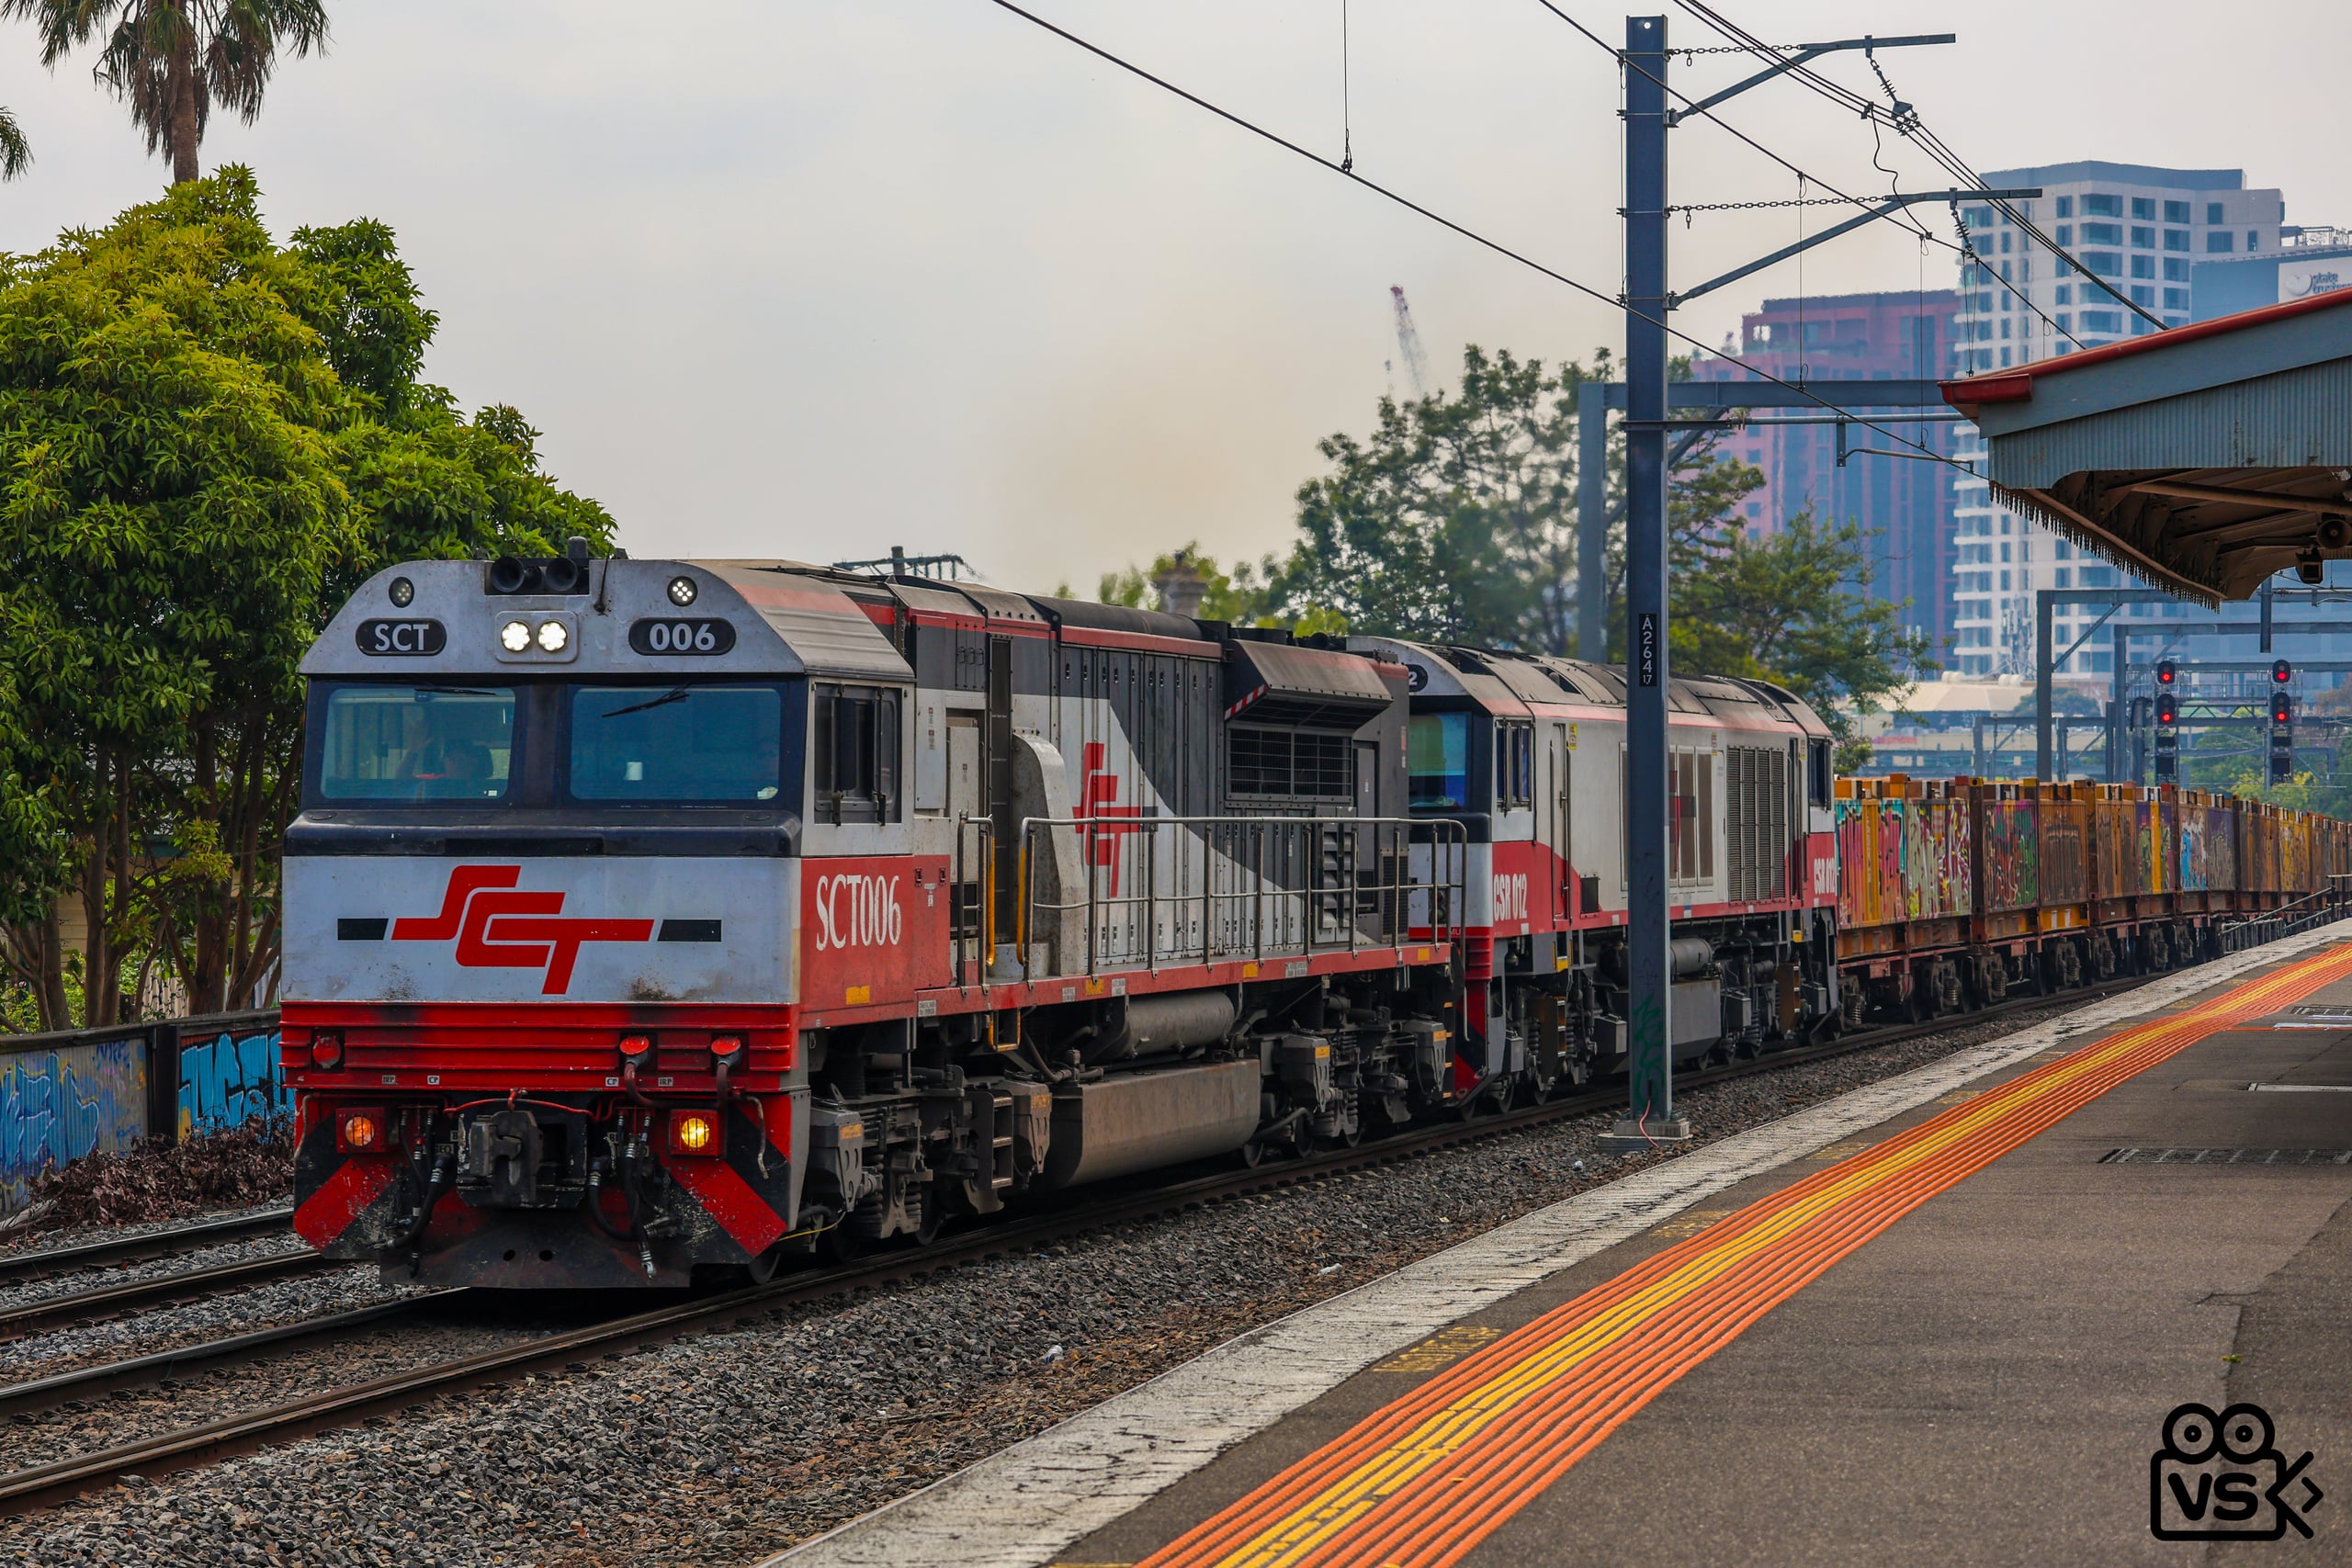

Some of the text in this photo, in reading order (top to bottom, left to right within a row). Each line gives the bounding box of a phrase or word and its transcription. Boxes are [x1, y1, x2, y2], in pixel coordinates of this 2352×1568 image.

[374, 623, 429, 652] SCT
[649, 623, 716, 652] 006
[816, 874, 901, 952] SCT006
[1494, 873, 1528, 921] CSR 012
[390, 865, 654, 995] SCT
[606, 1077, 617, 1086] CP
